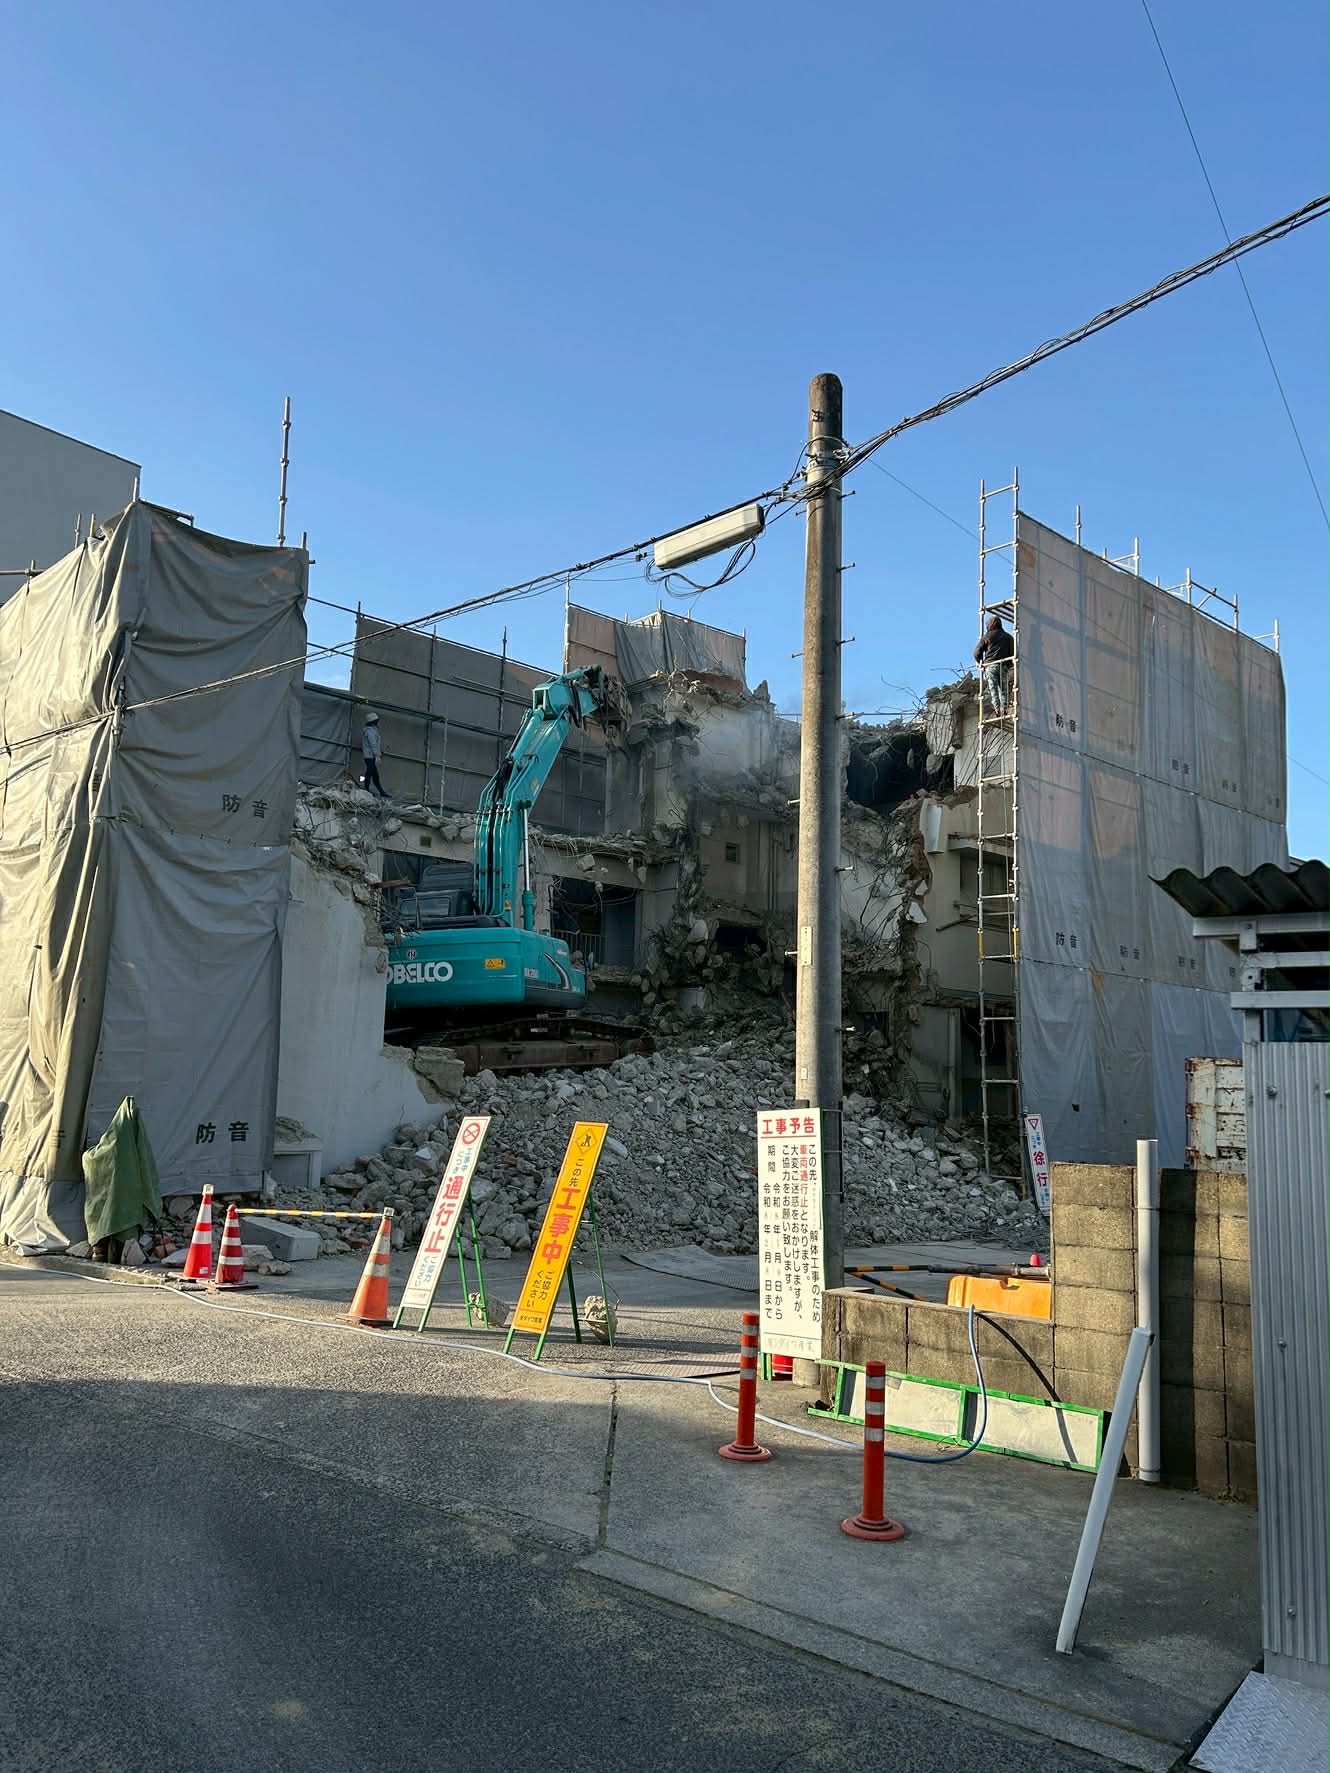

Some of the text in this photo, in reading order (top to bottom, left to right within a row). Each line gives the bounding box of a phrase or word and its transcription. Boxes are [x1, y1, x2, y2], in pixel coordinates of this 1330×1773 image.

[223, 794, 268, 818] 防音
[196, 1121, 249, 1144] 防音
[762, 1117, 815, 1134] 工事予告
[568, 1158, 583, 1187] この先
[1033, 1151, 1048, 1187] 徐行
[424, 1176, 464, 1252] 通行止
[543, 1187, 581, 1265] 工事中
[526, 1270, 544, 1307] ください
[538, 1271, 554, 1300] ご協力
